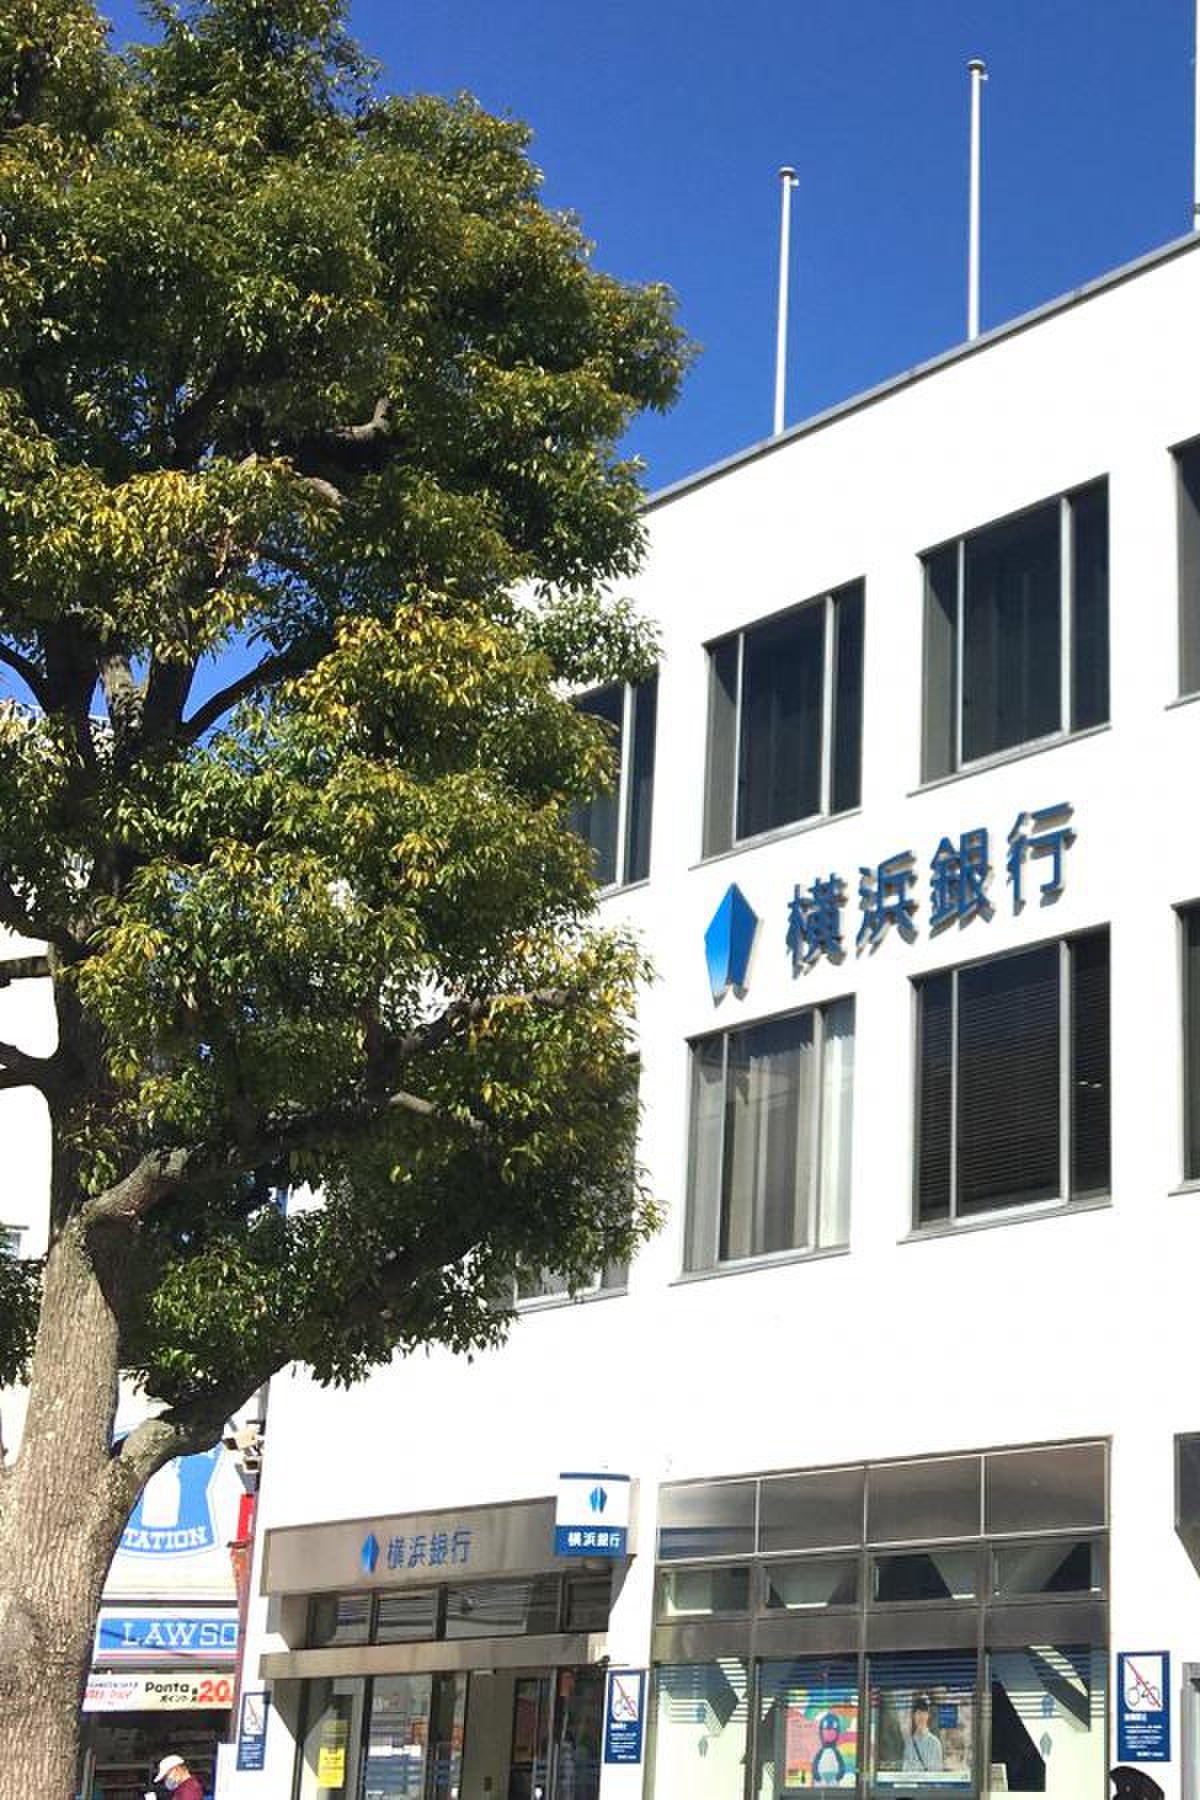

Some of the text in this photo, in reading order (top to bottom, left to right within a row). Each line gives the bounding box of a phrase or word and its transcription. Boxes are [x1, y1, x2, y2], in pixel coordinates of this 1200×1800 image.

[785, 801, 1078, 979] 横浜銀行
[121, 1525, 209, 1549] TATION
[567, 1532, 621, 1548] 横浜銀行
[387, 1530, 472, 1569] 横浜銀行
[121, 1622, 239, 1646] LAWSO
[145, 1681, 190, 1694] Ponta
